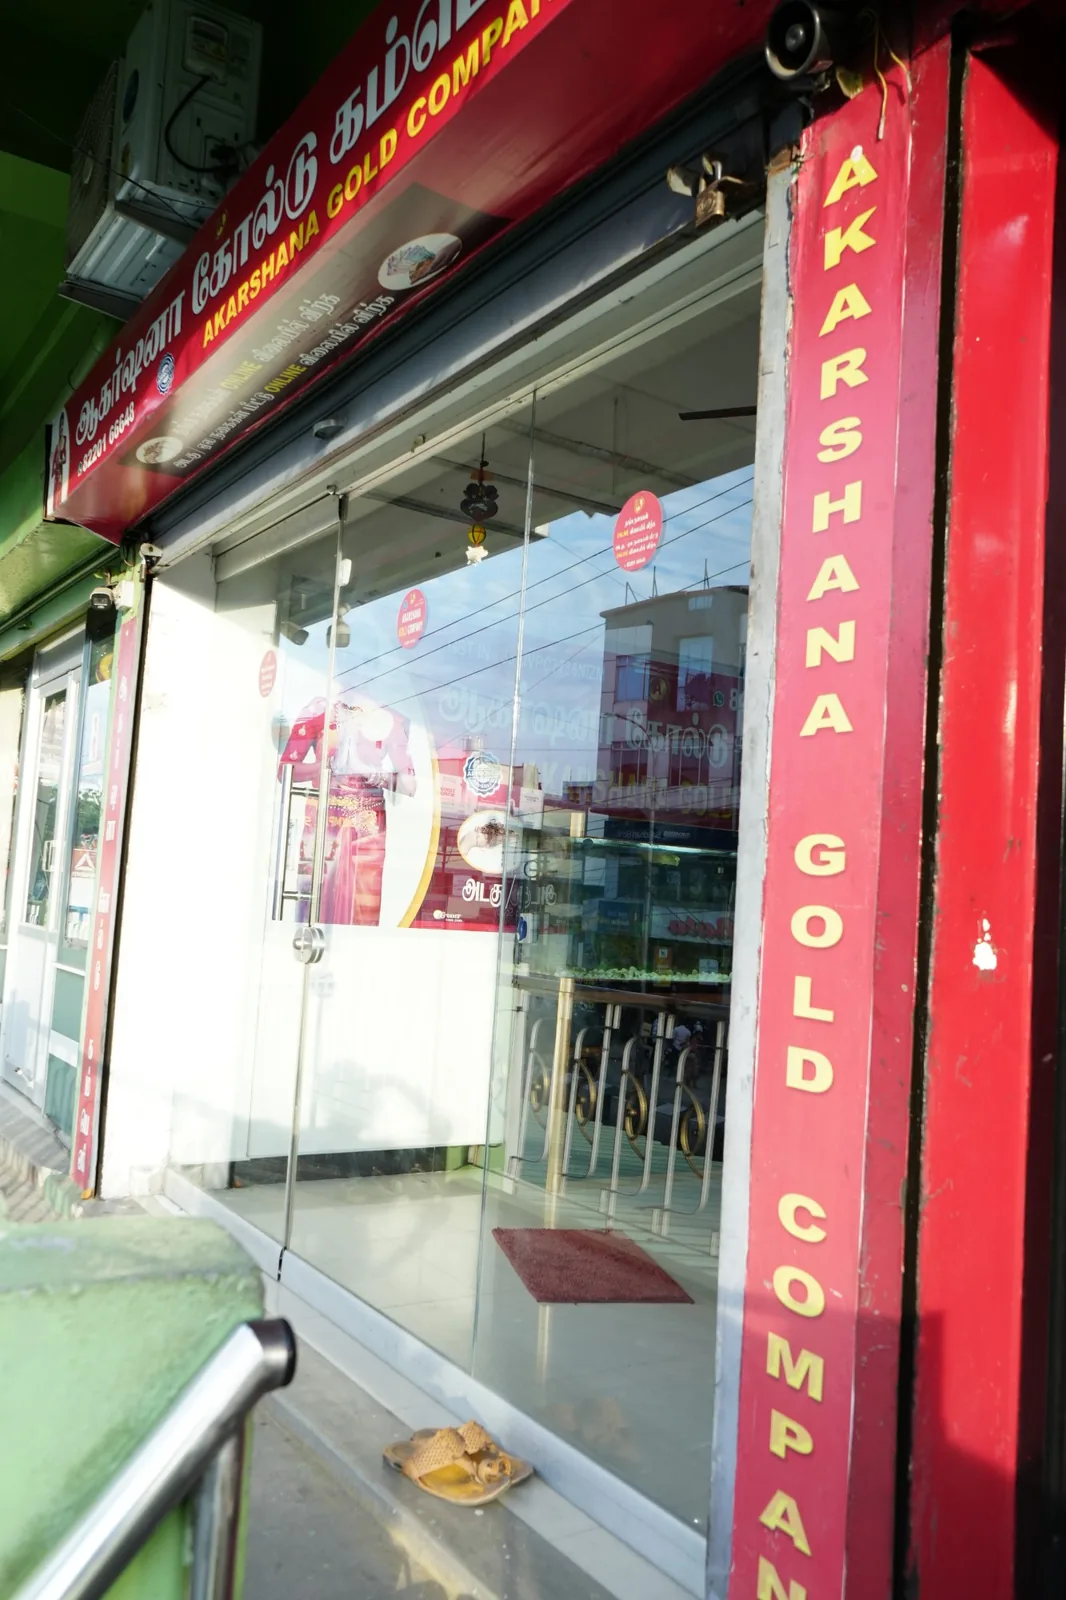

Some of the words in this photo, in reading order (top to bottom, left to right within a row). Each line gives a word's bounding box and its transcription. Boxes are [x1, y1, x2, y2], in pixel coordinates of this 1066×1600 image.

[192, 131, 318, 315] கோல்டு
[202, 210, 320, 348] AKARSHANA
[327, 127, 398, 219] GOLD
[82, 433, 107, 472] 82201
[108, 401, 135, 446] 66648
[220, 360, 264, 390] ONLINE
[264, 363, 307, 393] ONLINE
[799, 145, 879, 737] AKARSHANA
[785, 832, 847, 1094] GOLD
